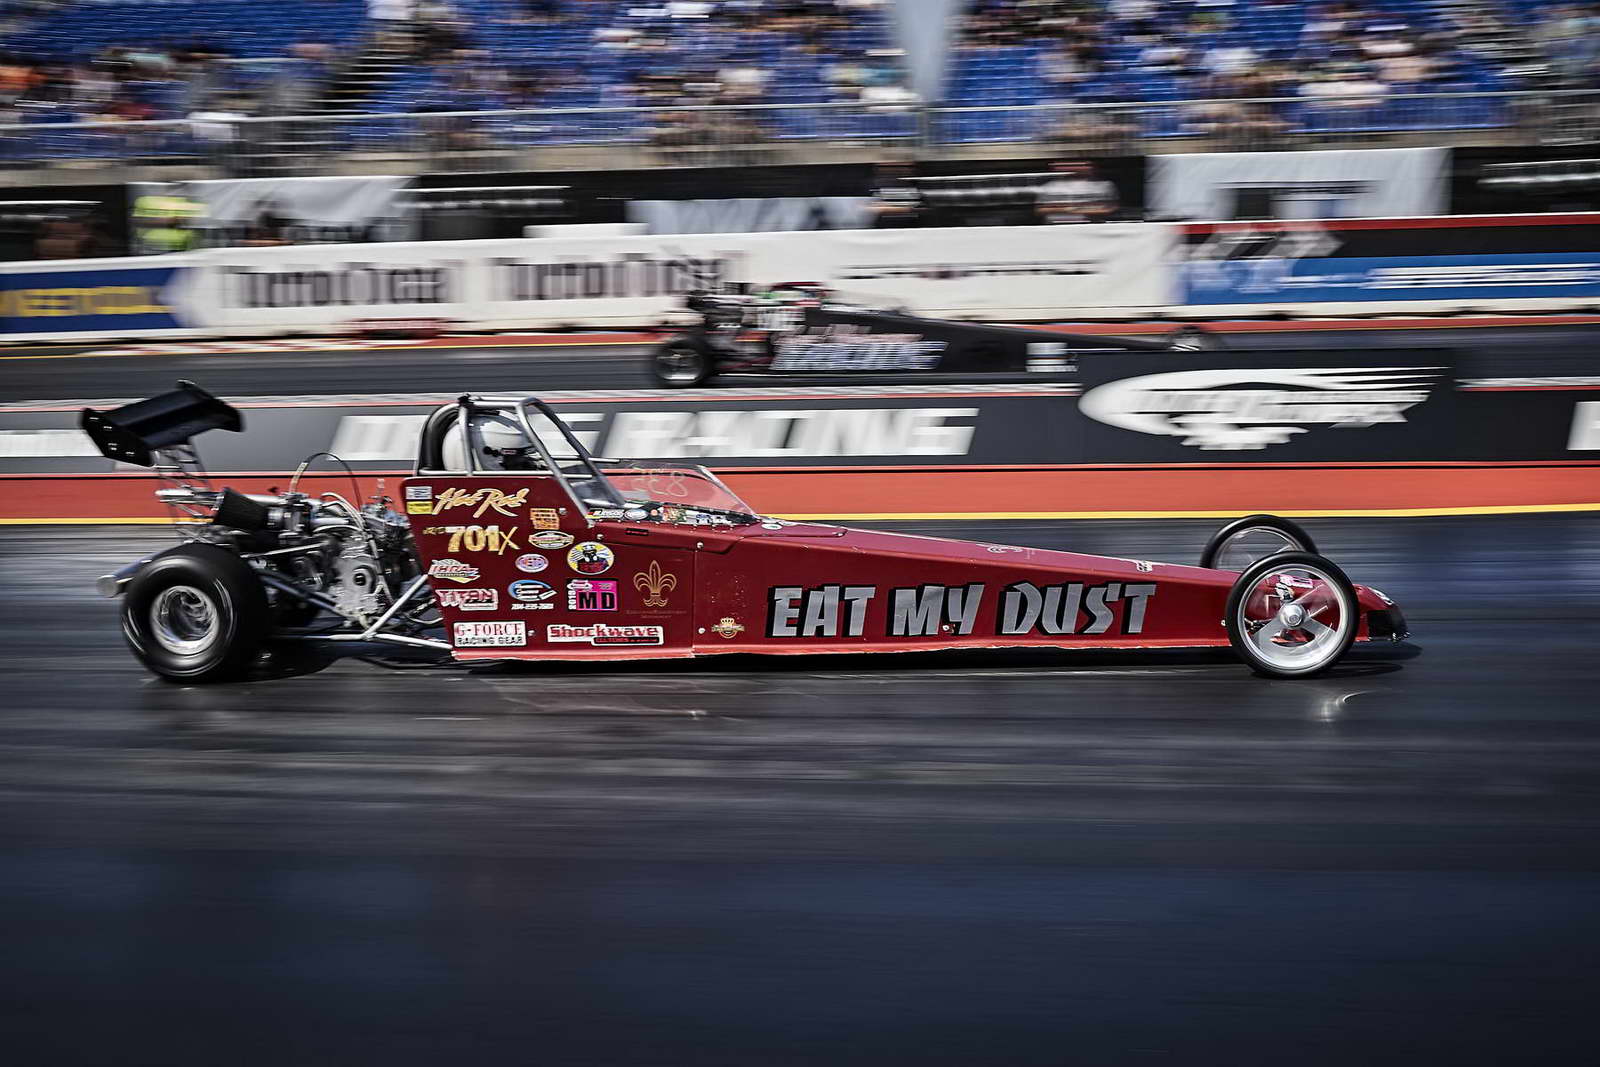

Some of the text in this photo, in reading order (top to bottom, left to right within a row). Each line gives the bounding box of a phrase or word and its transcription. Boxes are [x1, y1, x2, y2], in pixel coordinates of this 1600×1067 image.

[473, 487, 530, 518] Rod
[766, 583, 1157, 638] EAT MY DUST
[454, 623, 523, 636] G-FORCE
[549, 624, 659, 638] Shockwave
[498, 636, 523, 645] GEAR
